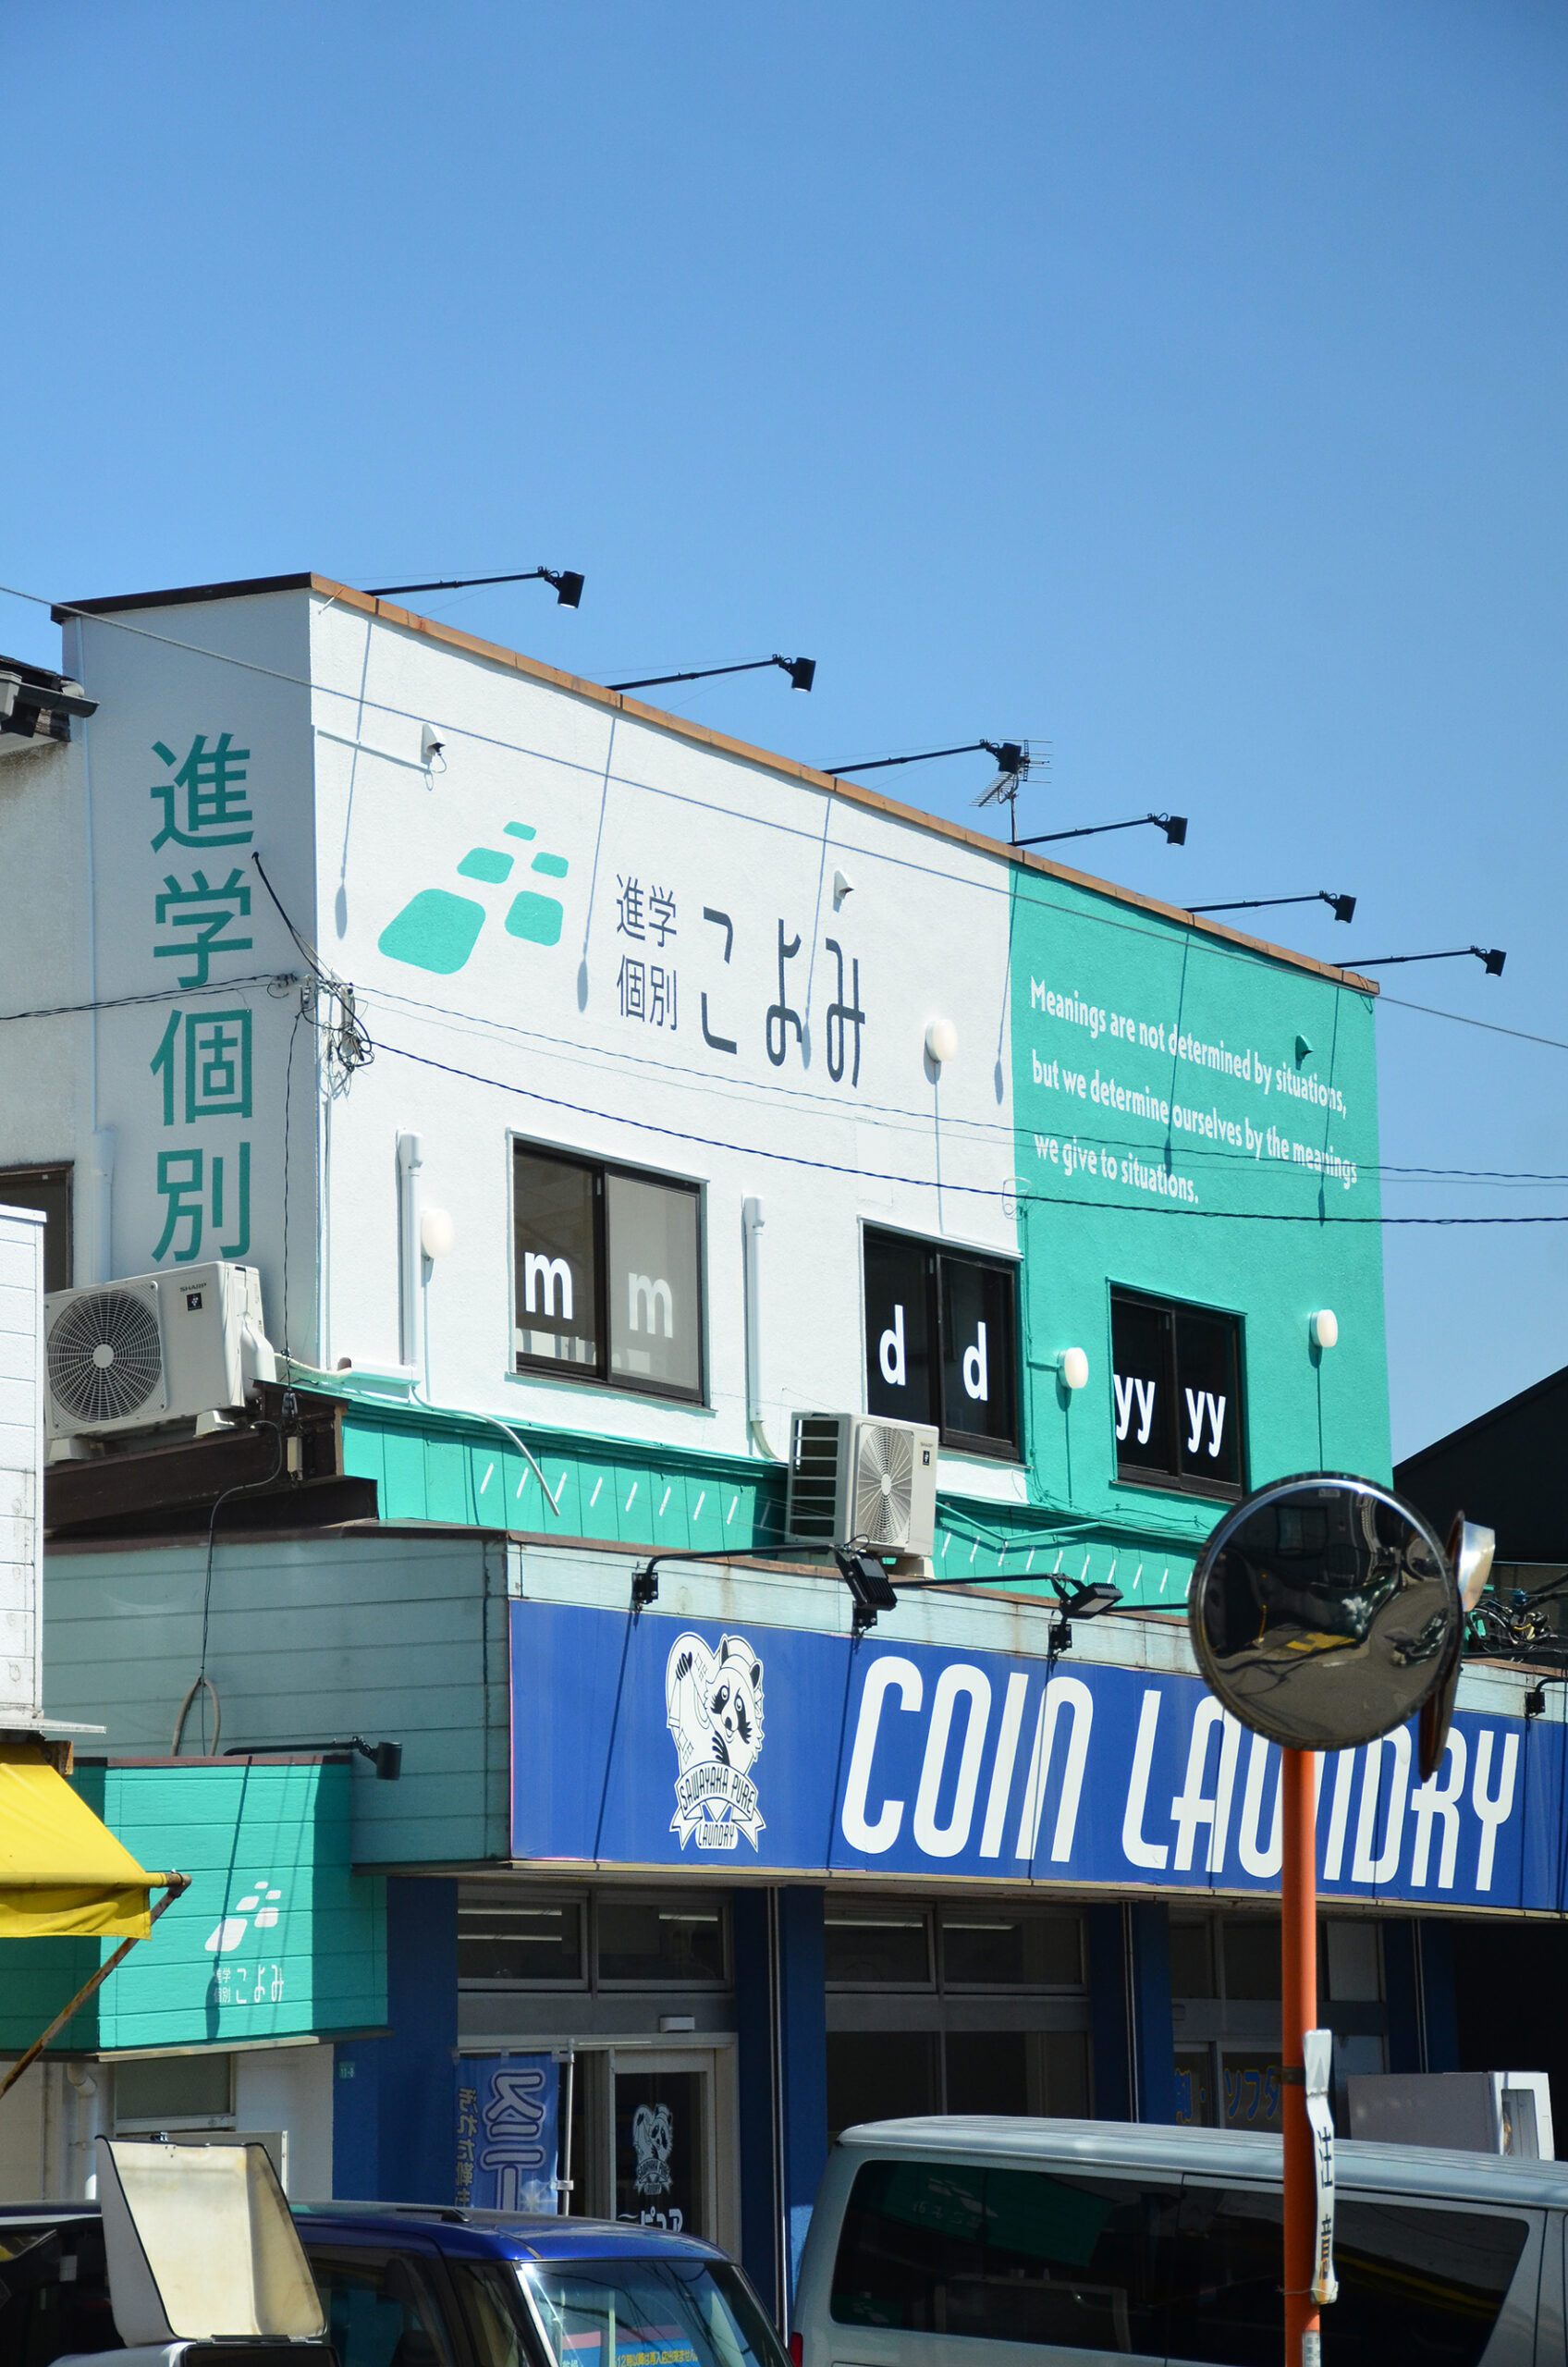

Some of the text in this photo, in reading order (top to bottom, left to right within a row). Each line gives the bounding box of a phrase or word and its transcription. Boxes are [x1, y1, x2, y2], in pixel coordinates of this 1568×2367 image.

[616, 873, 678, 948] 進学
[150, 732, 254, 1263] 進学個別
[616, 953, 678, 1031] 個別
[701, 906, 865, 1088] こよみ
[1030, 975, 1347, 1121] Meanings are not determined by situations,
[1032, 1048, 1358, 1190] but we determine ourselves by the meanings
[1034, 1134, 1199, 1204] we give to situations.
[179, 1282, 207, 1292] SHARP
[524, 1251, 674, 1339] m m
[879, 1305, 988, 1400] d d
[1112, 1373, 1227, 1458] yy yy
[680, 1766, 755, 1814] SAWAYAKA PURE
[841, 1655, 1095, 1863] COIN
[697, 1823, 735, 1846] LAUNDRY
[236, 1964, 284, 2005] こよみ
